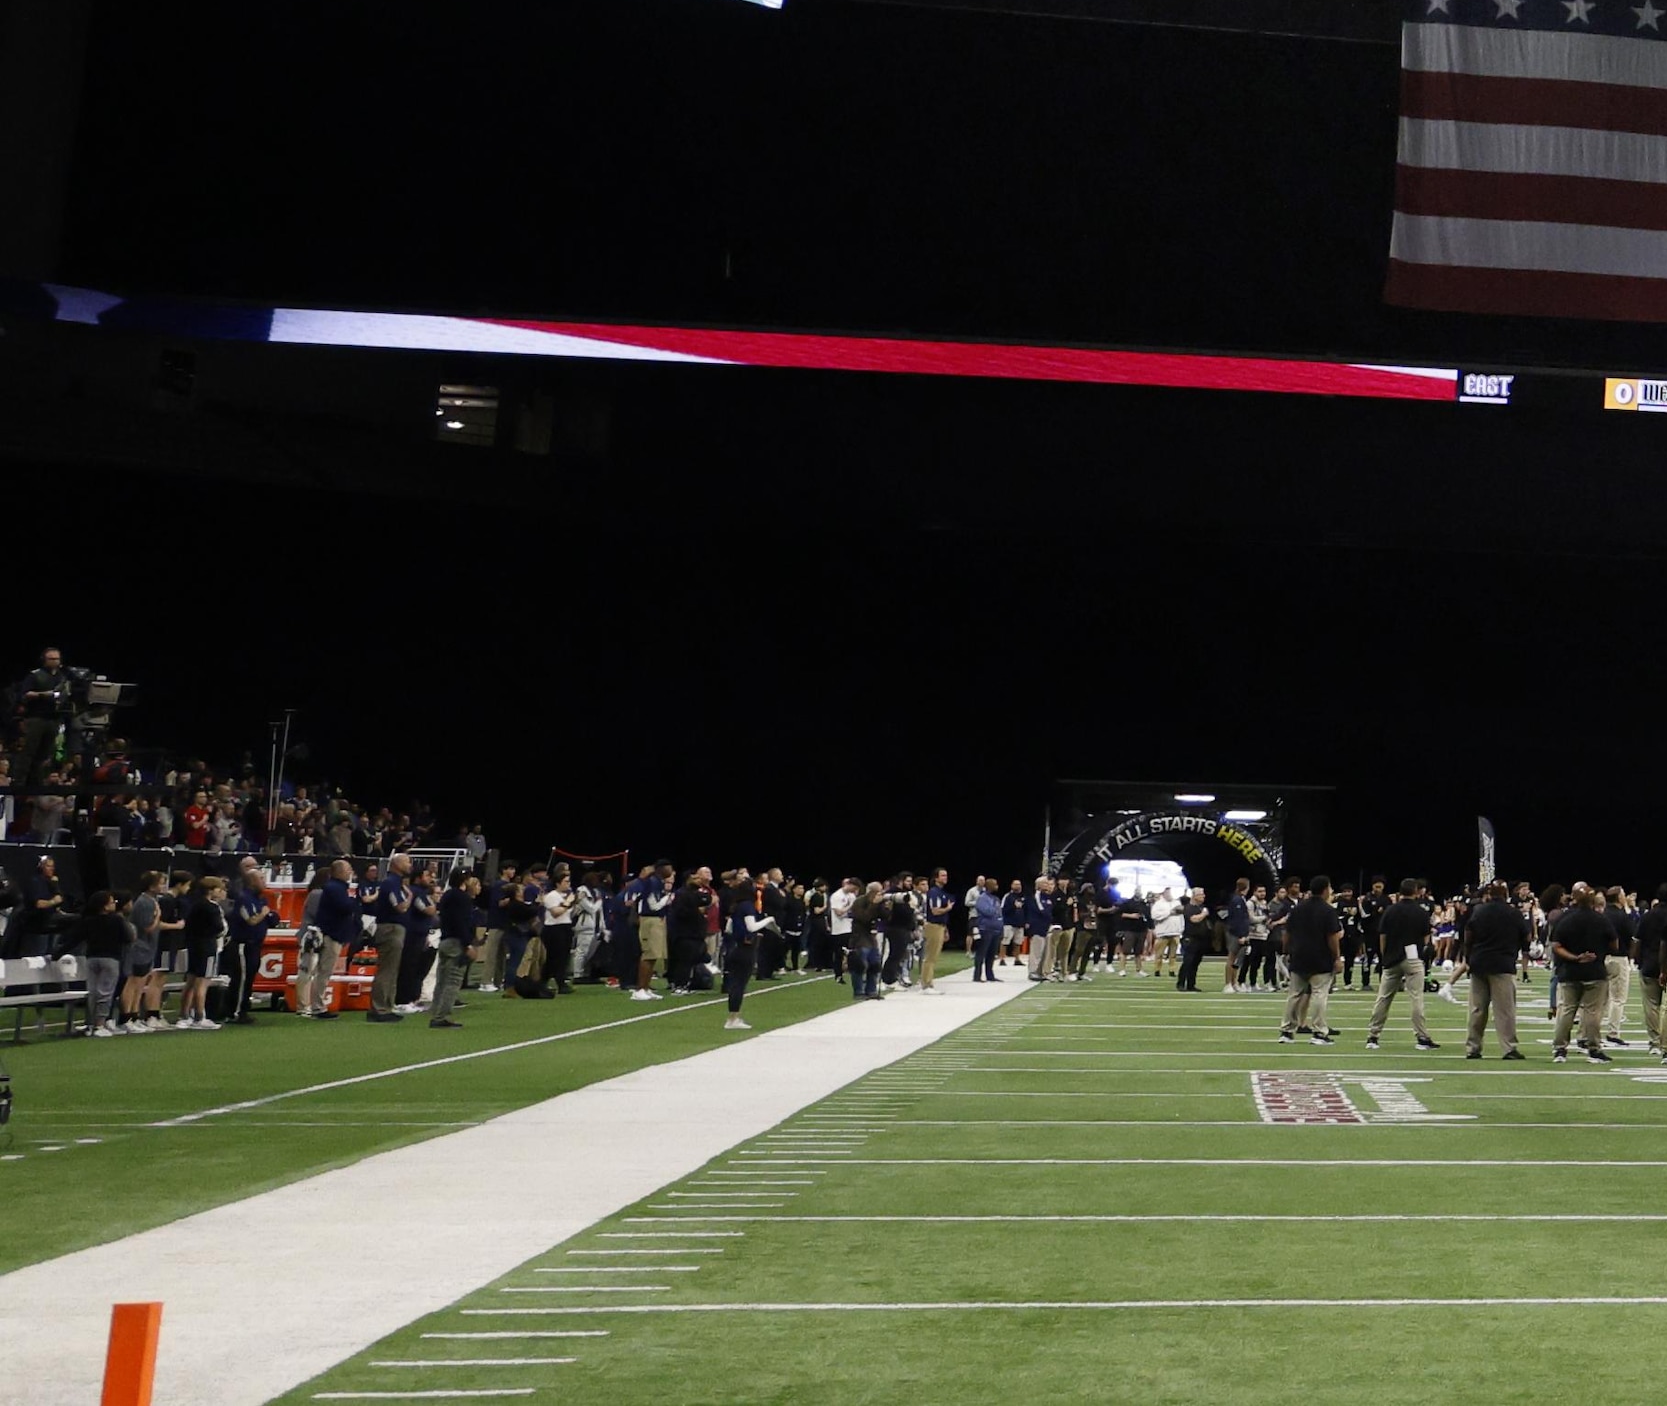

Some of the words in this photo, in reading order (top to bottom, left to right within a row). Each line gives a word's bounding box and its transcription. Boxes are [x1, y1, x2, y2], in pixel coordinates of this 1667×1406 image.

[1464, 374, 1514, 396] EAST
[1615, 383, 1633, 404] 0
[1097, 844, 1113, 862] IT
[1115, 825, 1148, 849] ALL
[1150, 817, 1217, 835] STARTS
[1217, 825, 1263, 864] HERE
[258, 953, 283, 978] G
